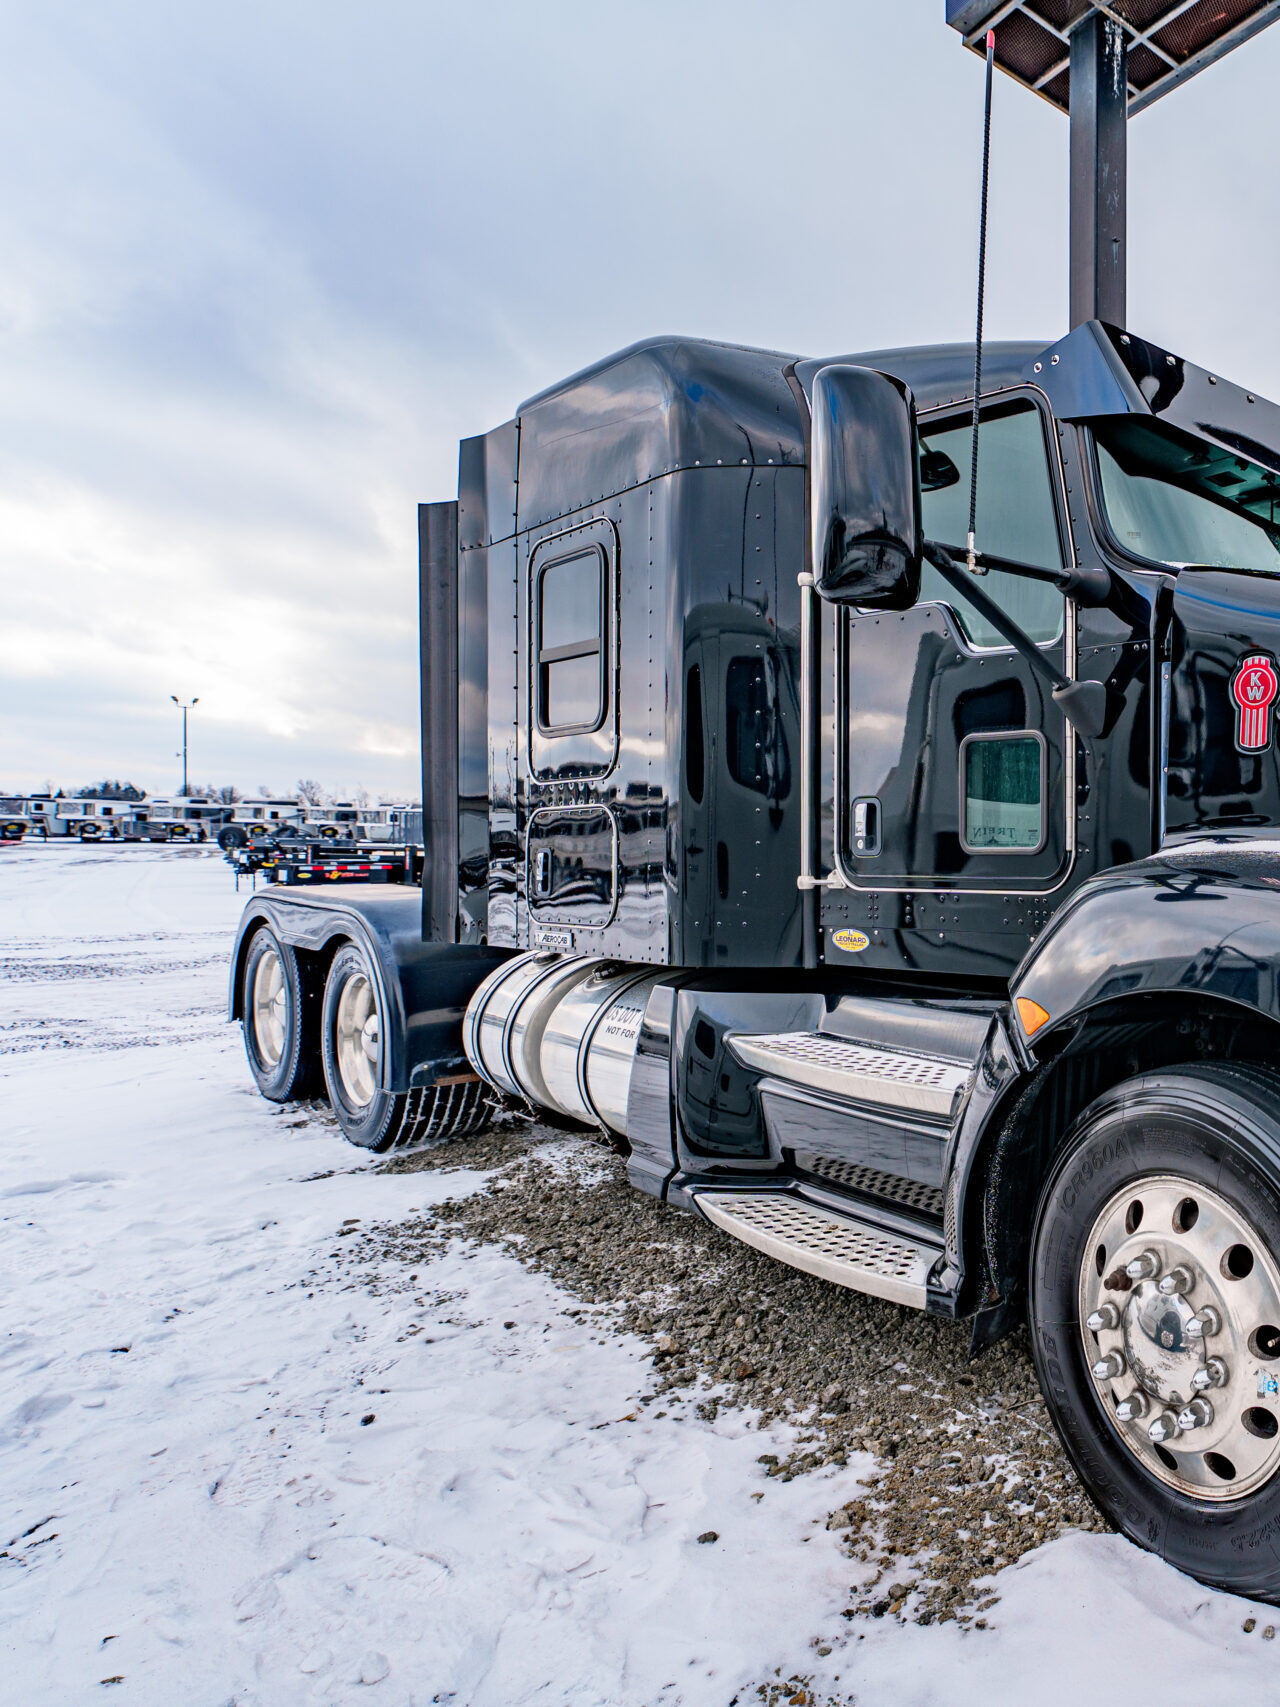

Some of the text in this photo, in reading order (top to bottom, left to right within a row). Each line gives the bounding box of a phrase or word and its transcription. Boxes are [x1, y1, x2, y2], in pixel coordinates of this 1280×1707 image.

[835, 935, 867, 943] LEONARD
[606, 1025, 620, 1035] NOT
[621, 1029, 636, 1039] FOR
